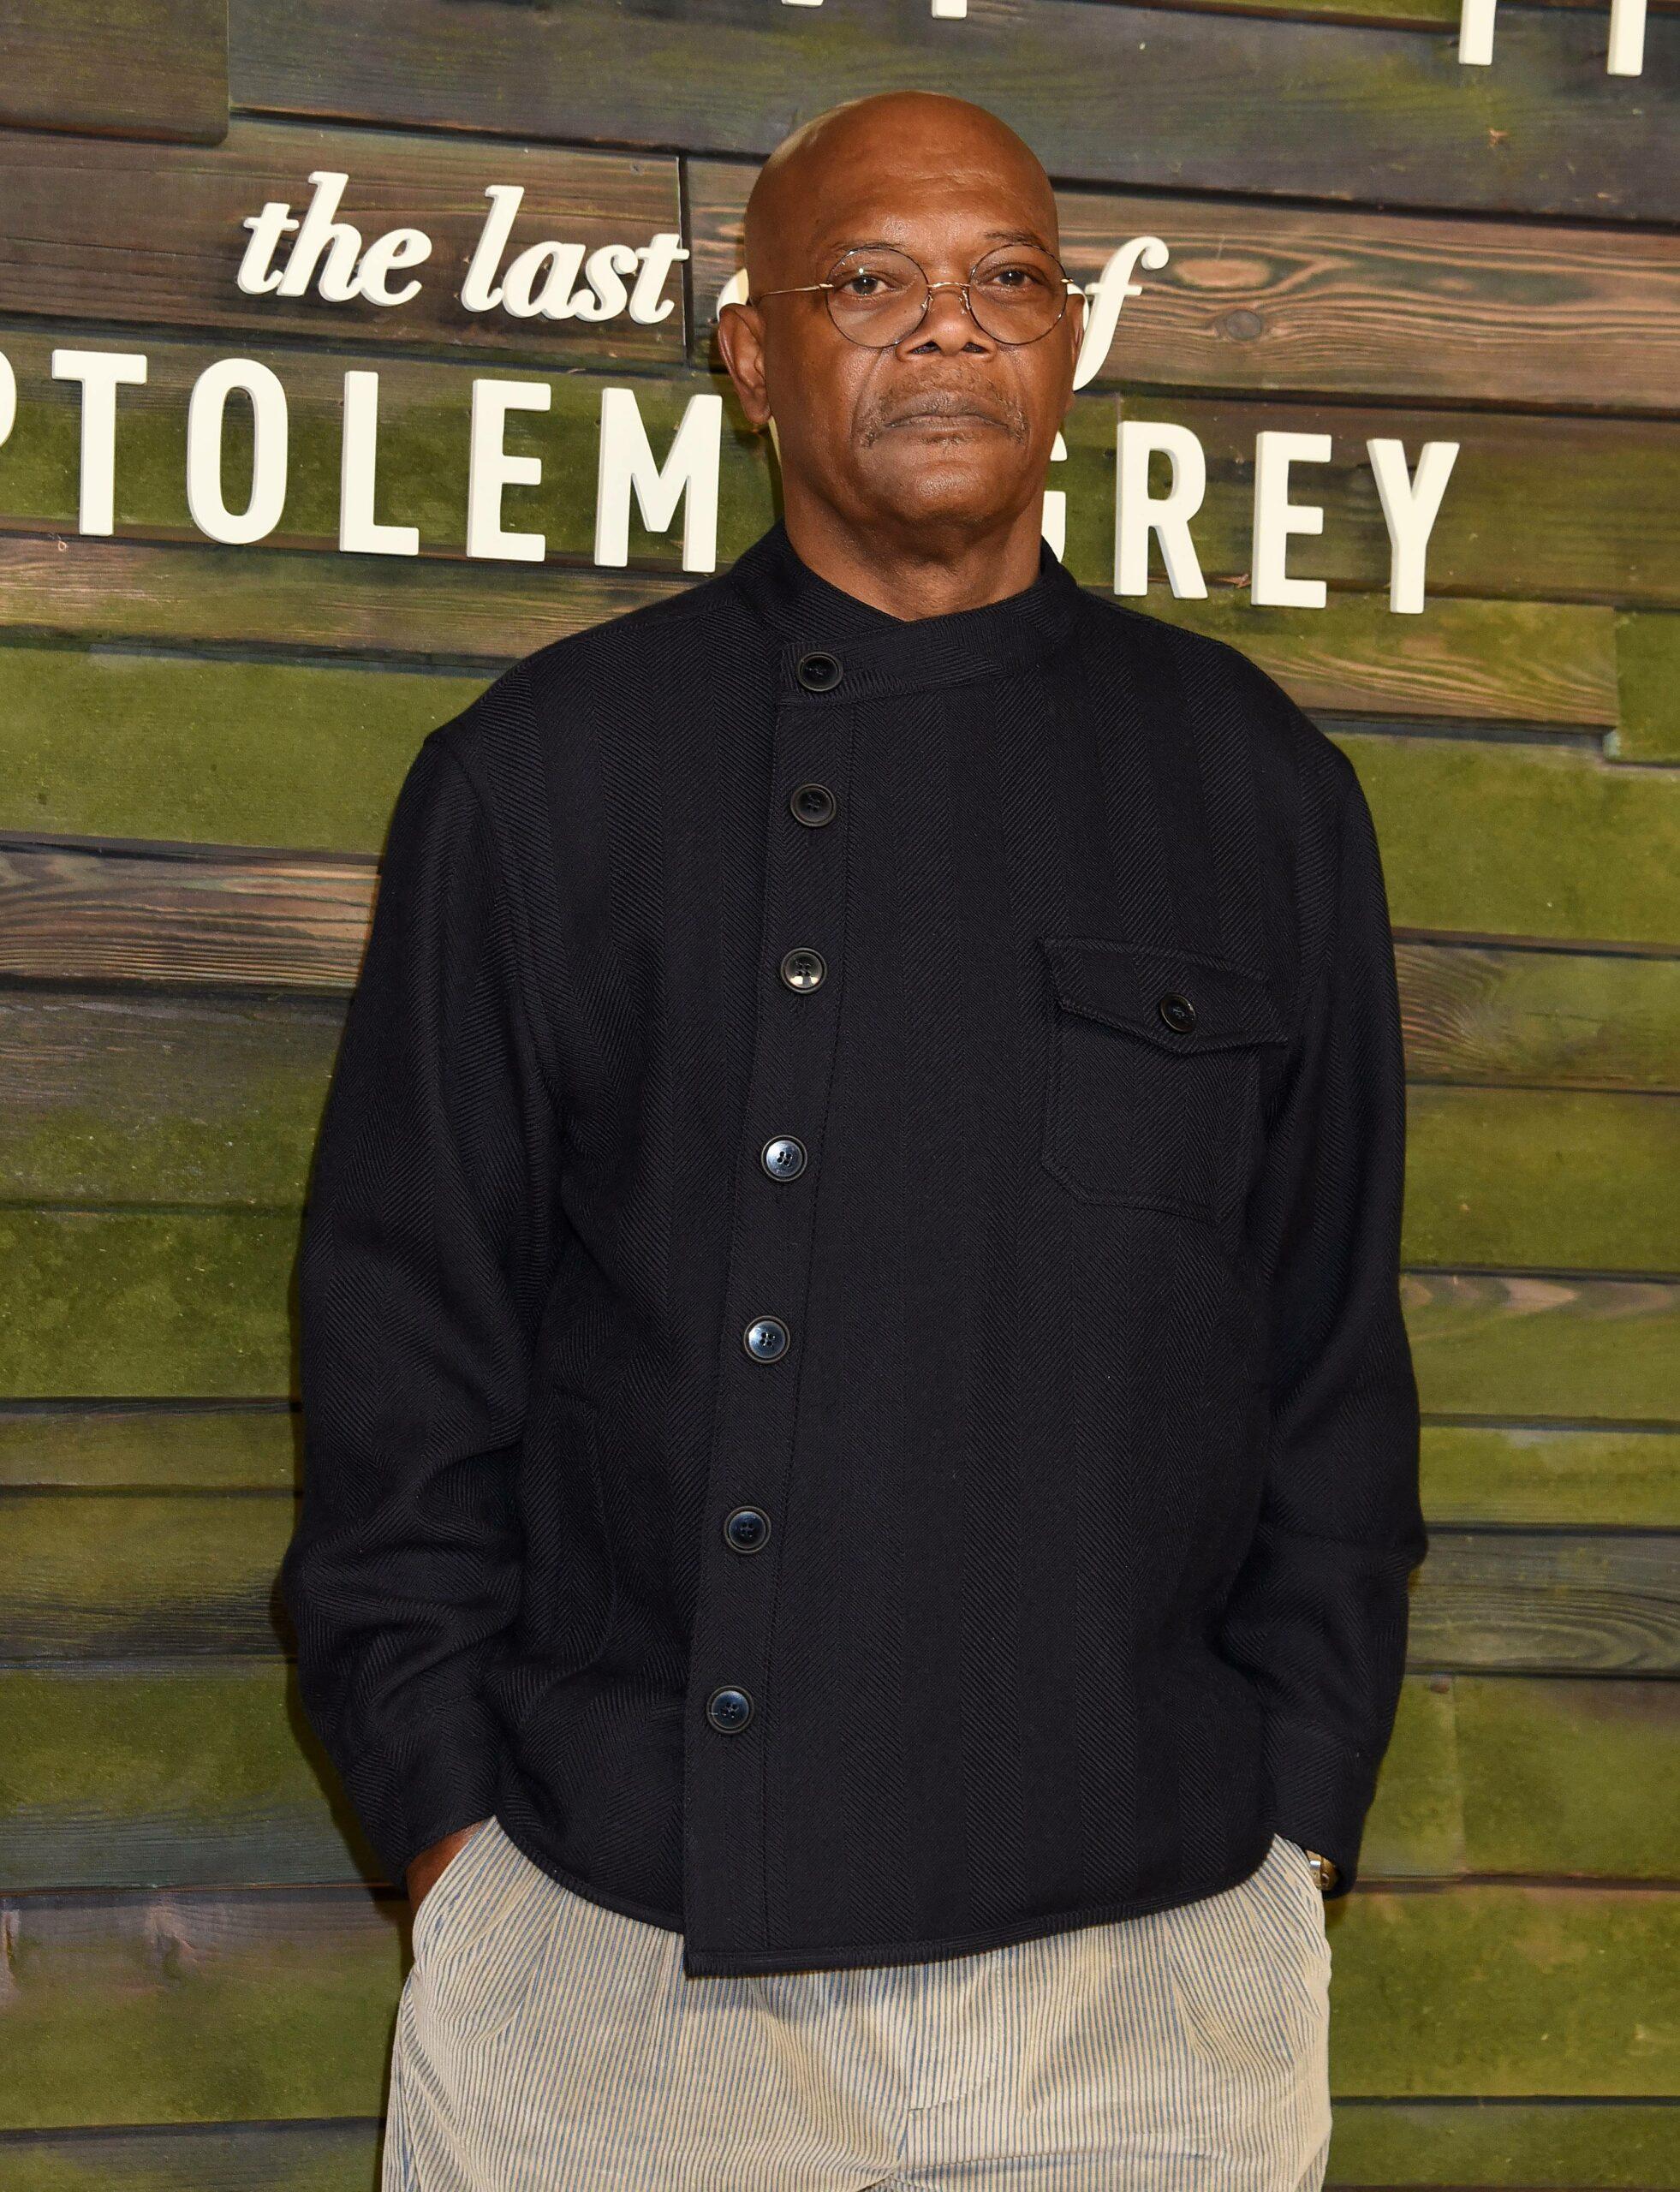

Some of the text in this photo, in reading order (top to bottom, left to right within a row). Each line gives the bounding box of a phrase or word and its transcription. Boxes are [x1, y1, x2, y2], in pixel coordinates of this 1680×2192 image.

[236, 170, 1170, 392] the last f
[0, 348, 782, 574] TOLEM
